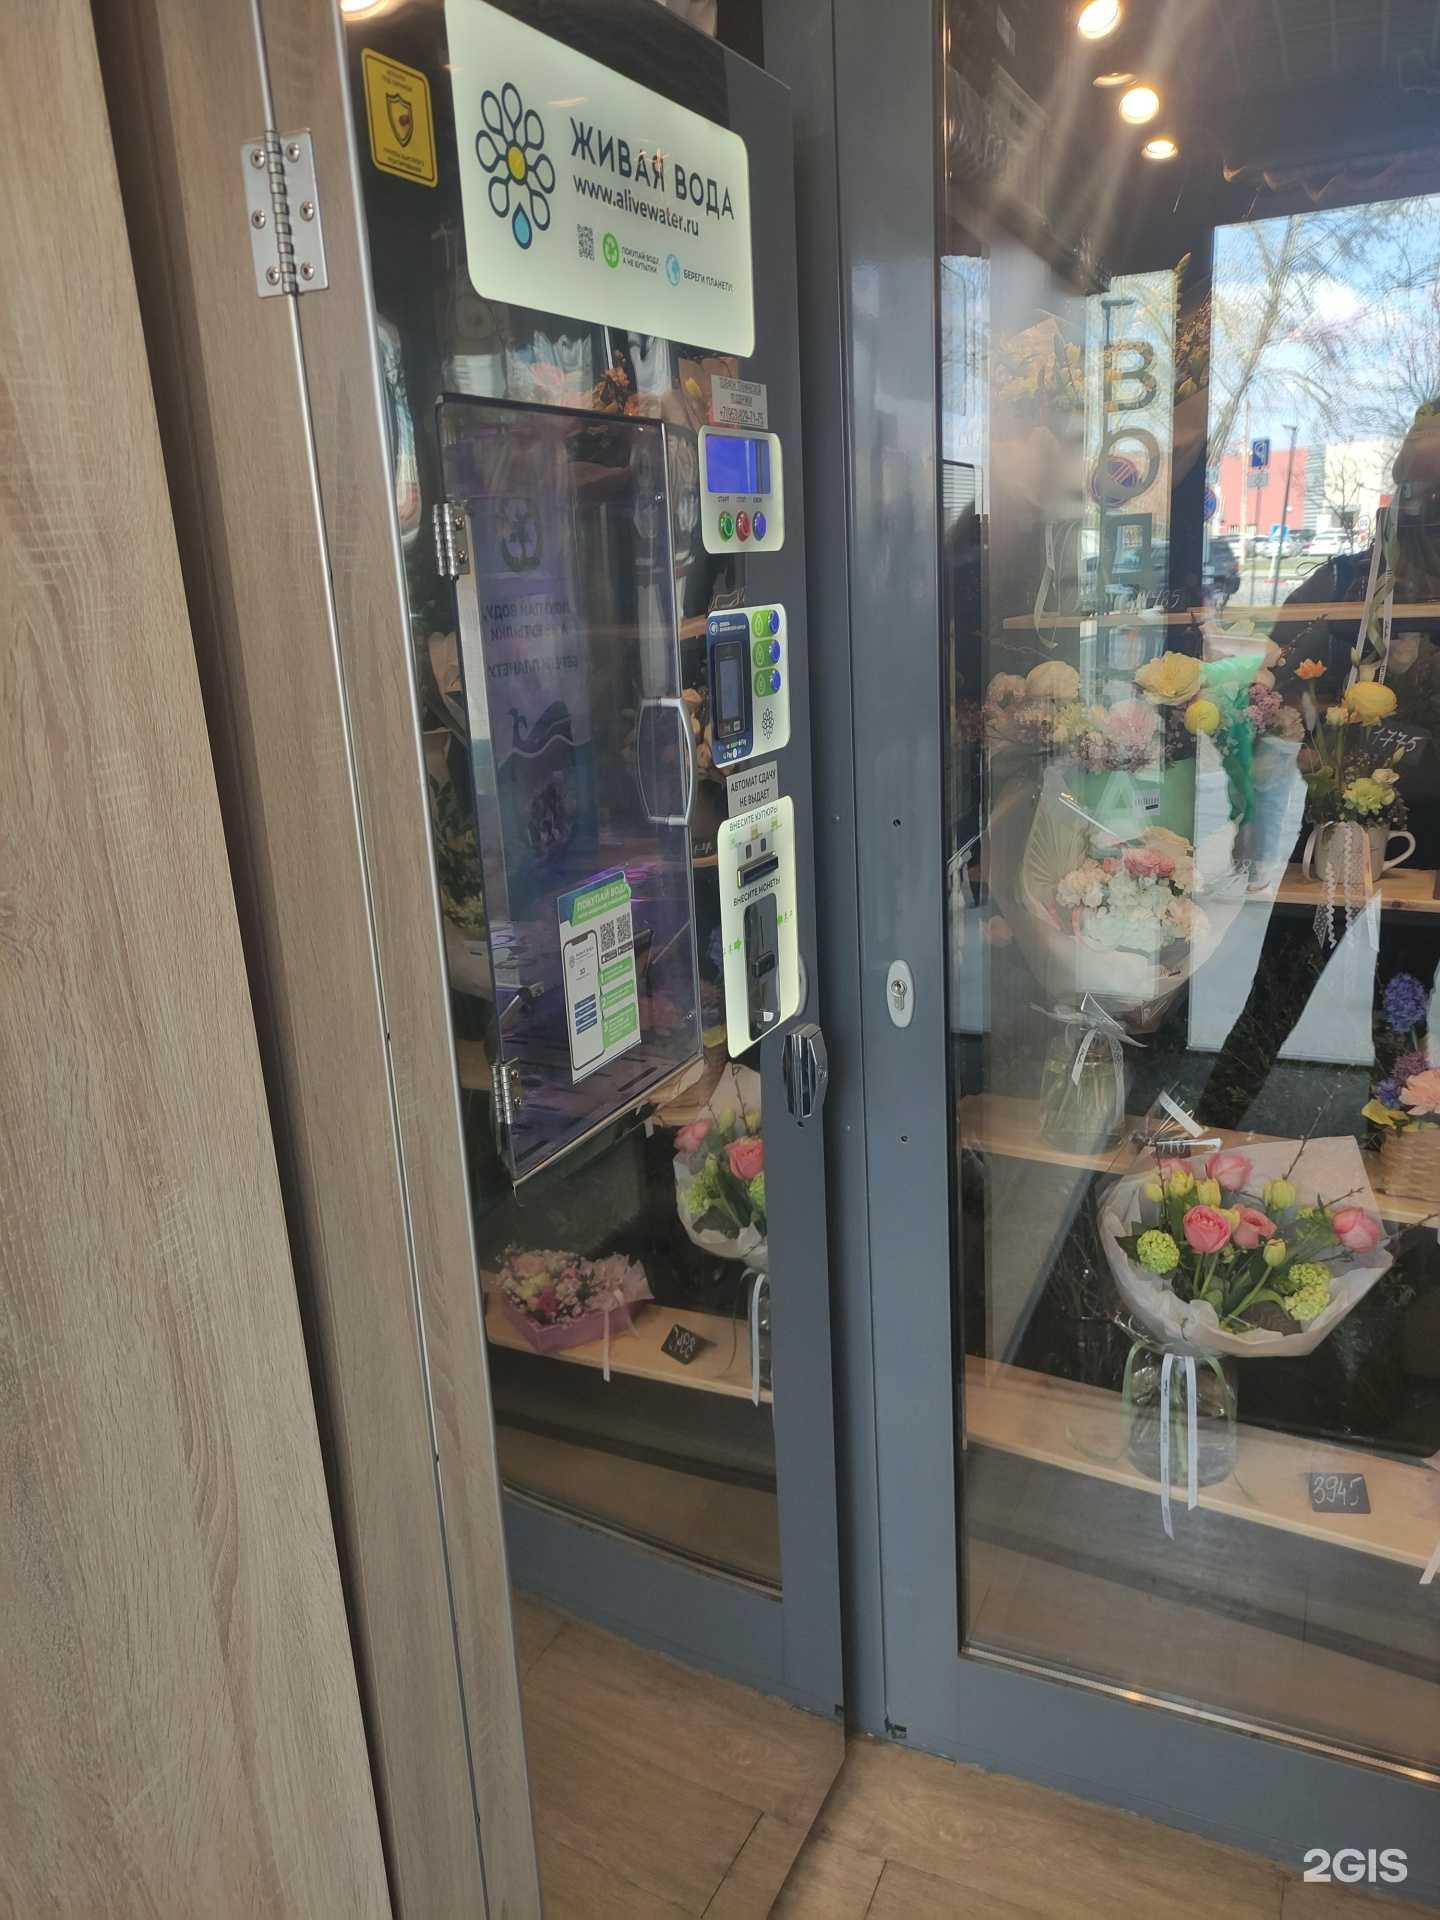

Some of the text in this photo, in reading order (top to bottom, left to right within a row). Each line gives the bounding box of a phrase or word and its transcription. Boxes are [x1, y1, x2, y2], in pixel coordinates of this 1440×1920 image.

[570, 116, 735, 220] ЖИВАЯ ВОДА
[572, 174, 700, 237] www.alivewater.ru
[683, 268, 705, 285] БЕРЕГИ
[730, 769, 776, 793] АВТОМАТ СДАЧУ
[740, 788, 770, 807] НЕ ВЫДАЕТ
[729, 813, 755, 832] ВНЕСИТЕ
[733, 886, 758, 907] ВНЕСИТЕ
[1312, 1475, 1363, 1506] 3945
